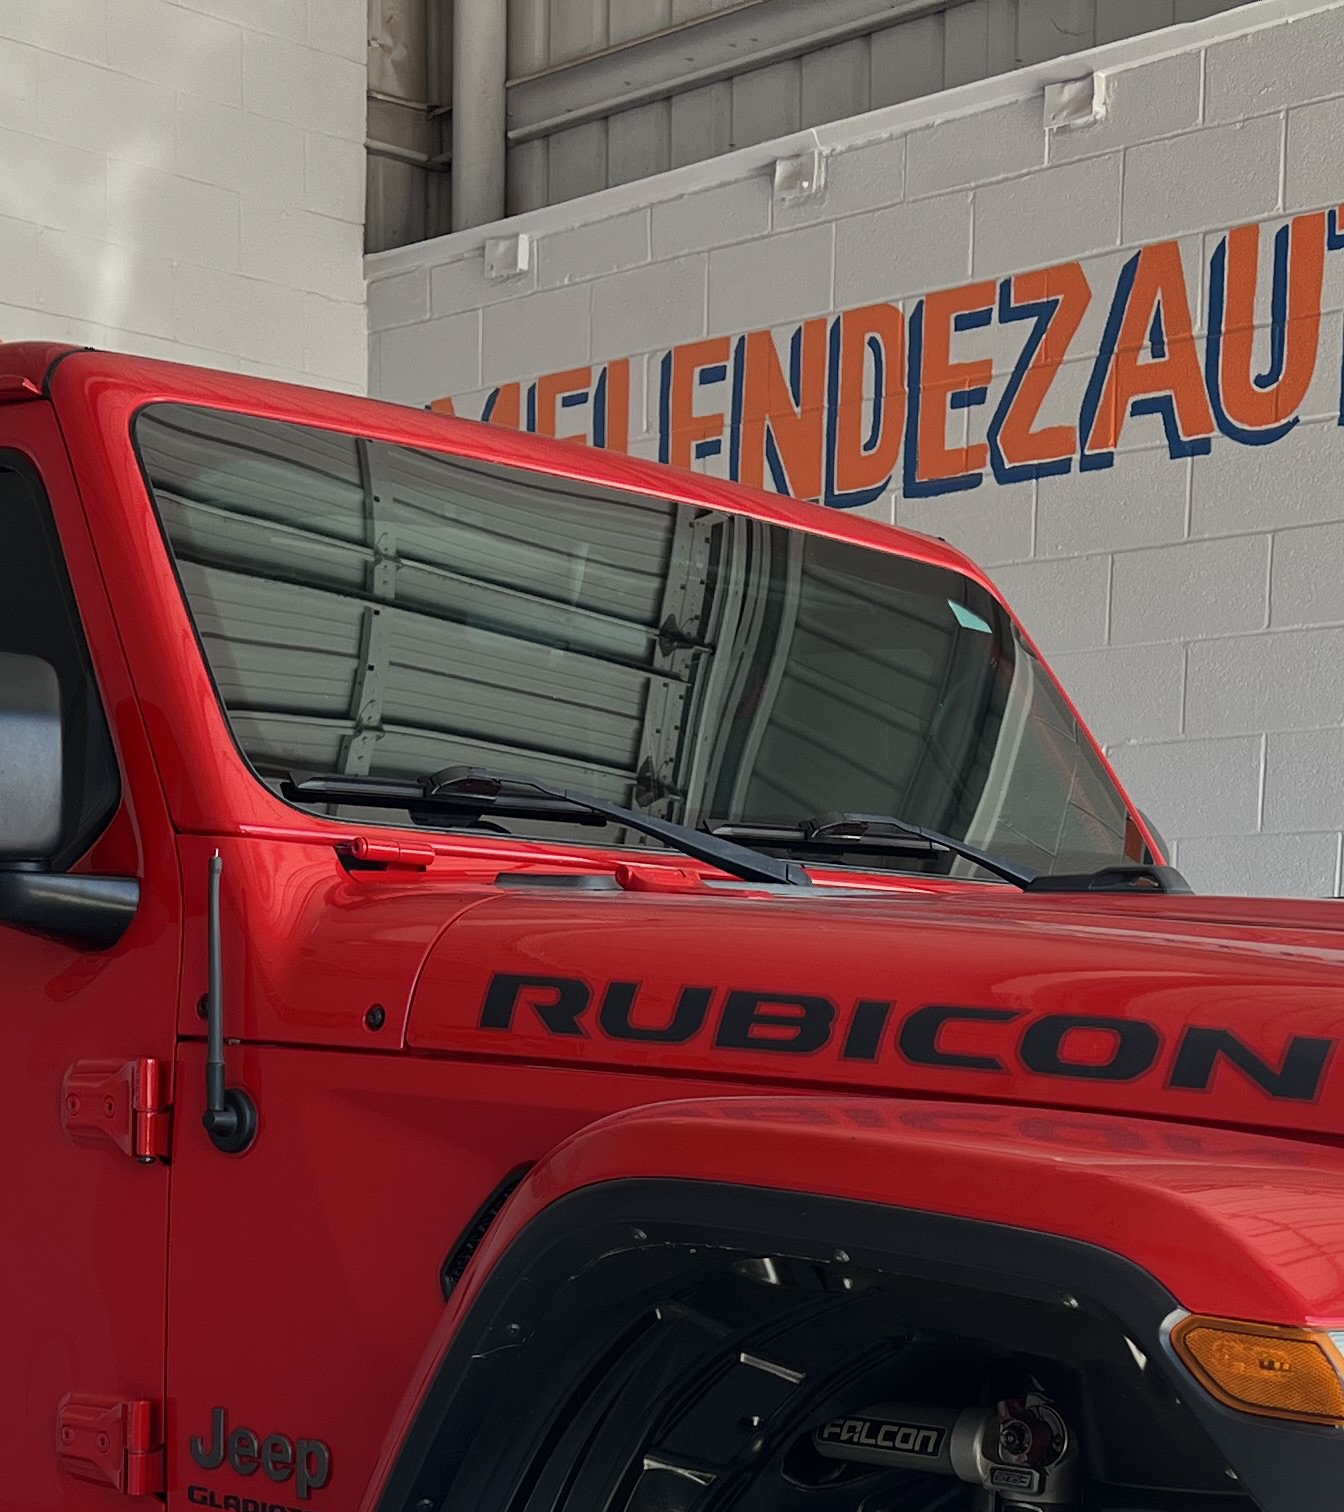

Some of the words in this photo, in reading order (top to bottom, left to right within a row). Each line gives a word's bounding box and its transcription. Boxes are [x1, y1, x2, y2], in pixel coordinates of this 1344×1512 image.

[479, 972, 1340, 1104] RUBICON
[191, 1407, 332, 1500] Jeep
[823, 1417, 938, 1453] FALCON
